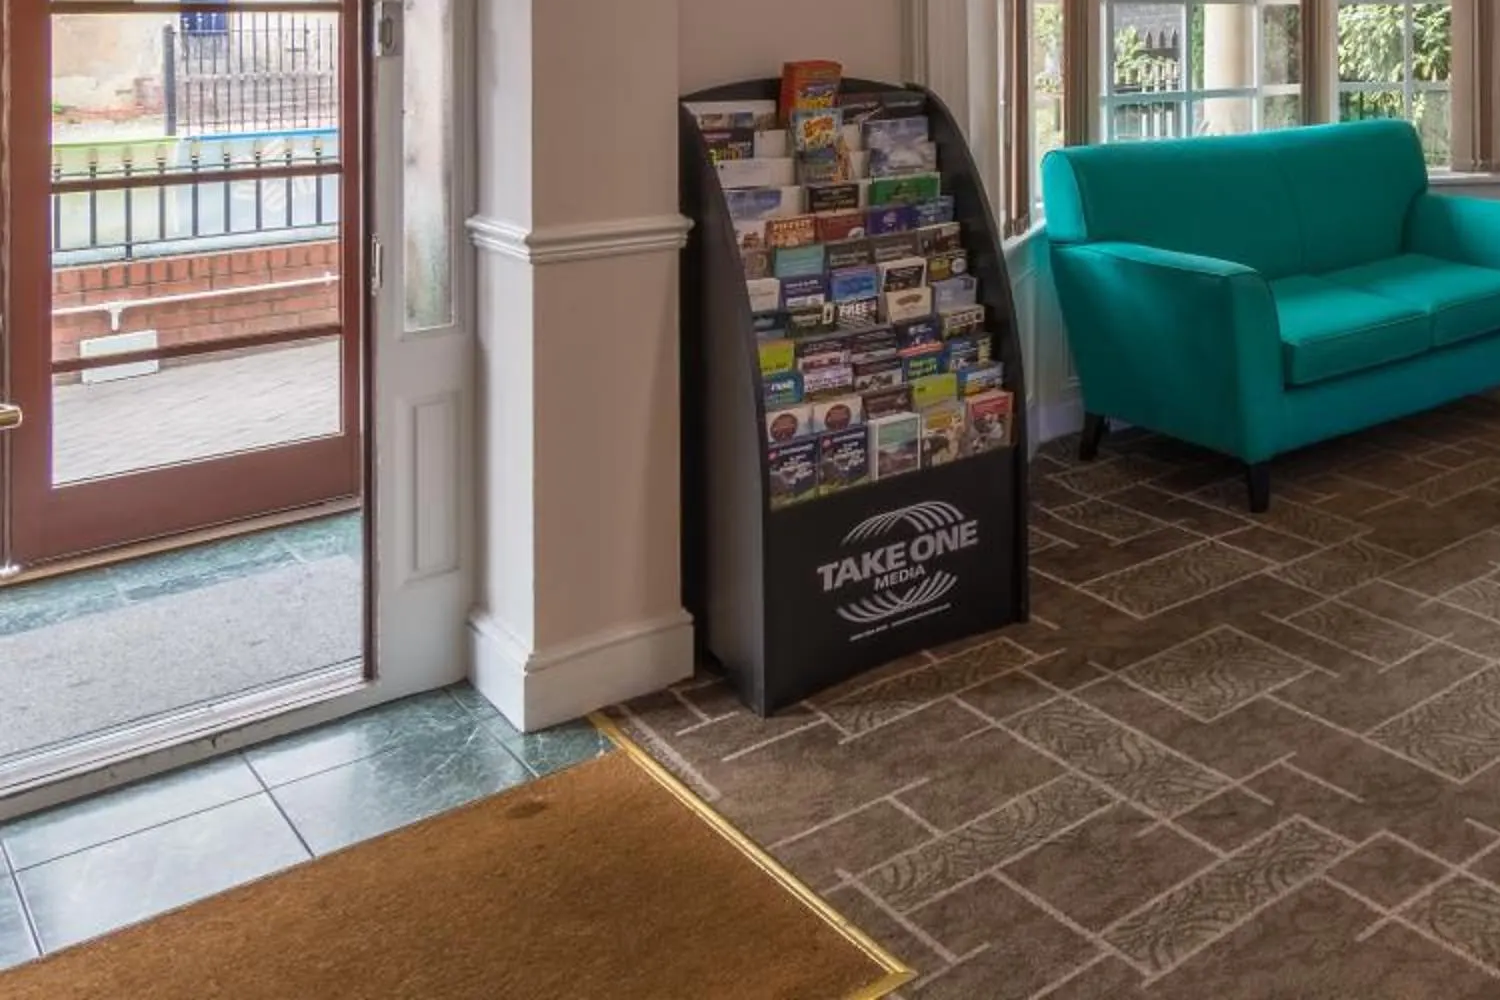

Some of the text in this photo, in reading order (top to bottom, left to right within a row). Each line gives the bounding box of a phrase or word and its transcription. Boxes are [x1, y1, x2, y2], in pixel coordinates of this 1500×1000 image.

[816, 519, 979, 592] TAKE ONE
[874, 563, 926, 591] MEDIA
